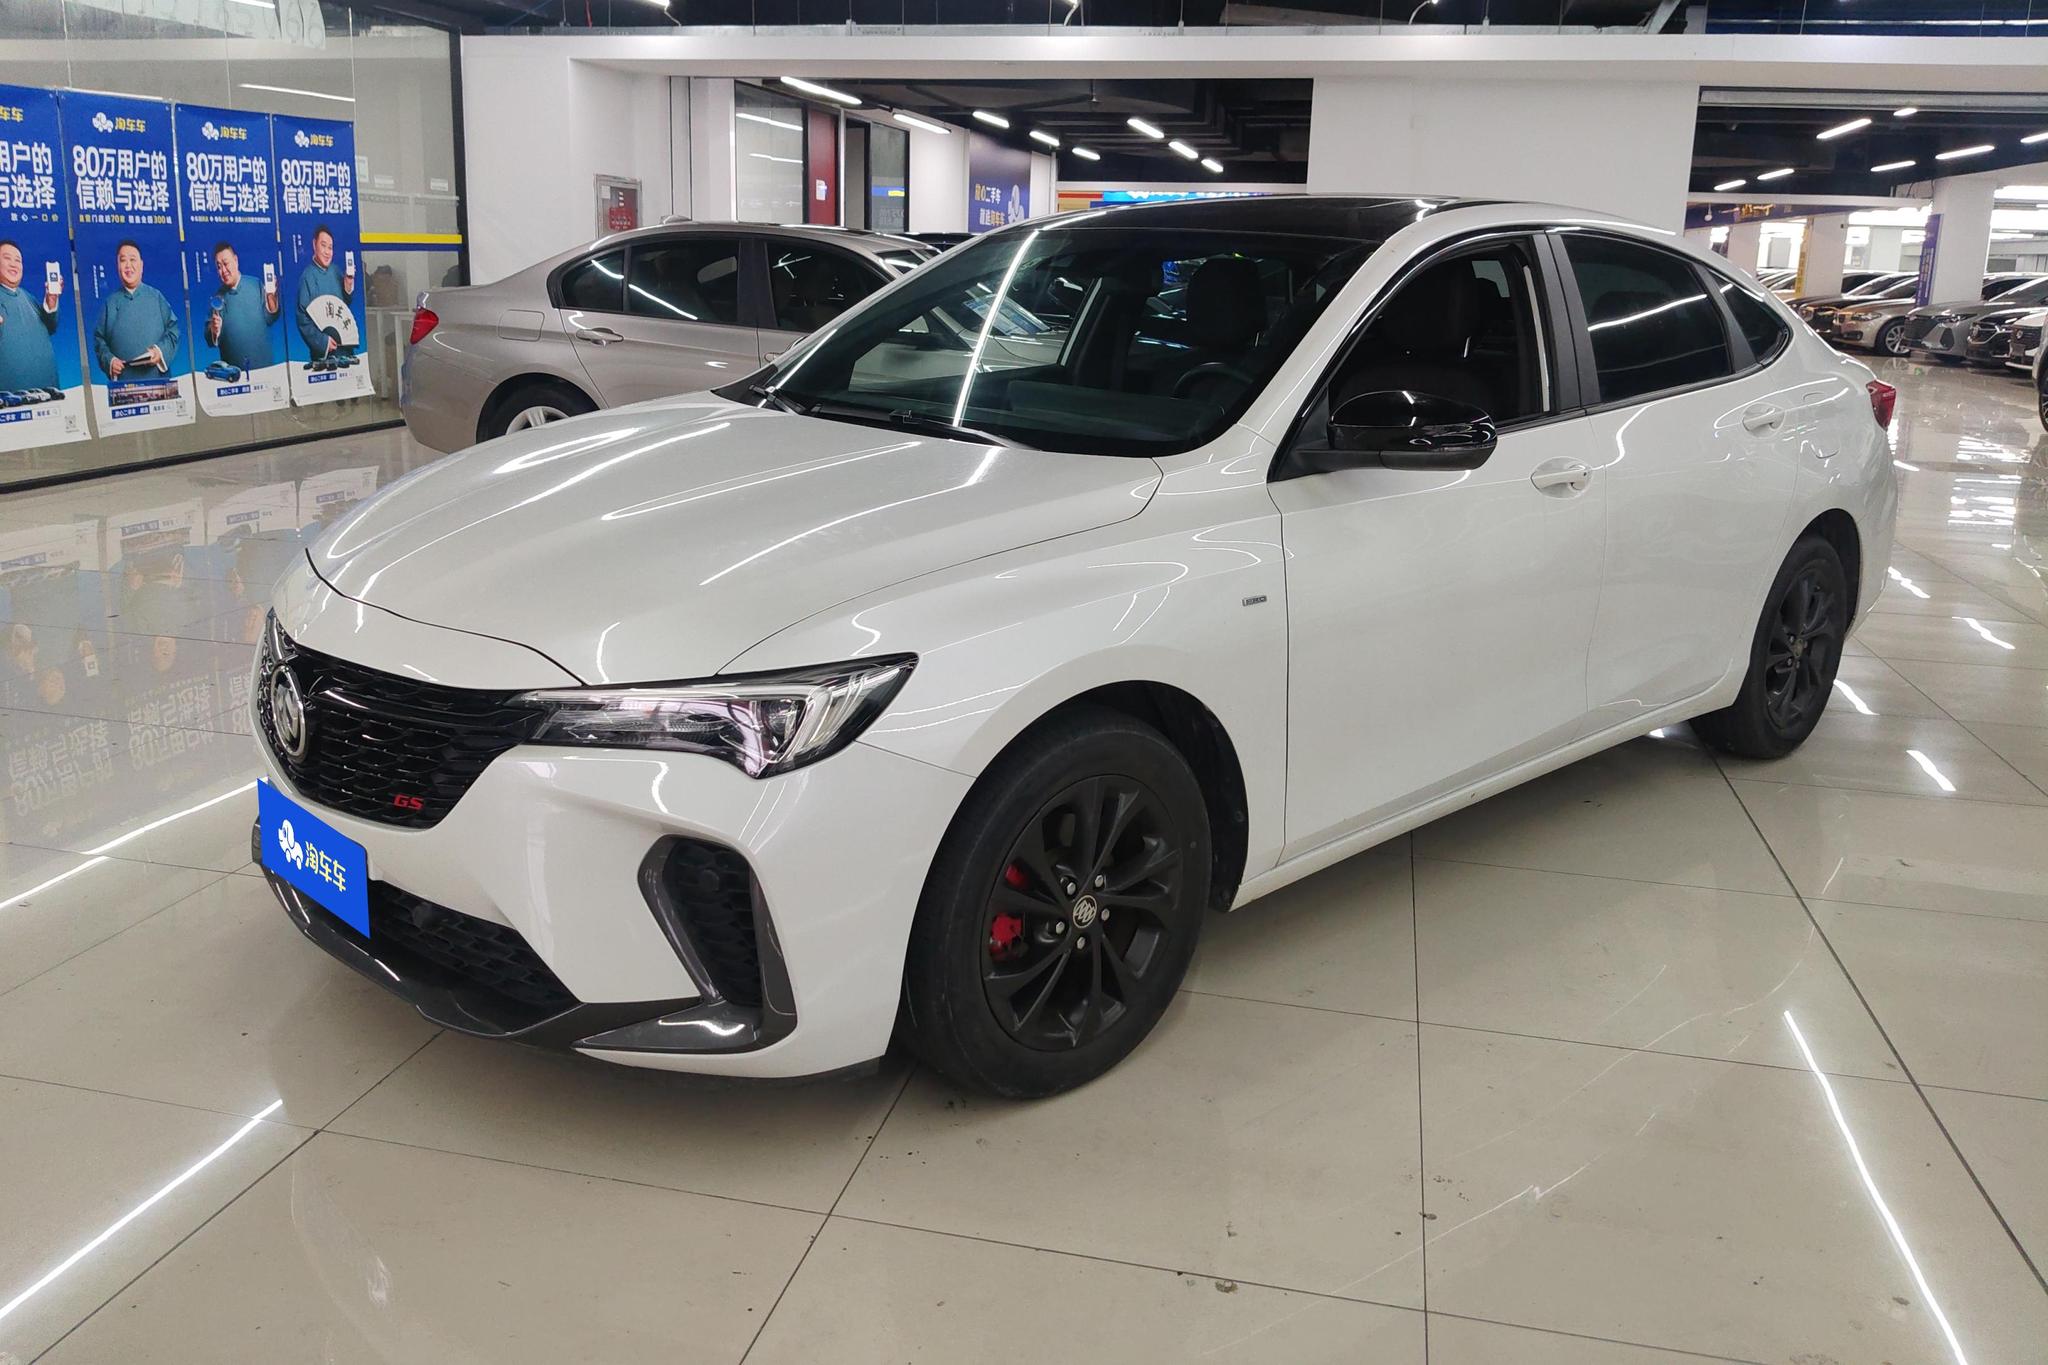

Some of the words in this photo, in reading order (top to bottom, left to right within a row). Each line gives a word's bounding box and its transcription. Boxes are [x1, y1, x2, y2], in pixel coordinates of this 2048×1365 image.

[114, 116, 146, 133] 淘车车
[220, 126, 247, 141] 淘车车
[310, 133, 334, 148] 淘车车
[73, 145, 168, 180] 80万用户的
[186, 152, 267, 184] 80万用户的
[281, 158, 351, 188] 80万用户的
[77, 176, 170, 212] 信赖与选择
[189, 181, 270, 214] 信赖与选择
[283, 184, 353, 215] 信赖与选择
[394, 794, 424, 810] GS
